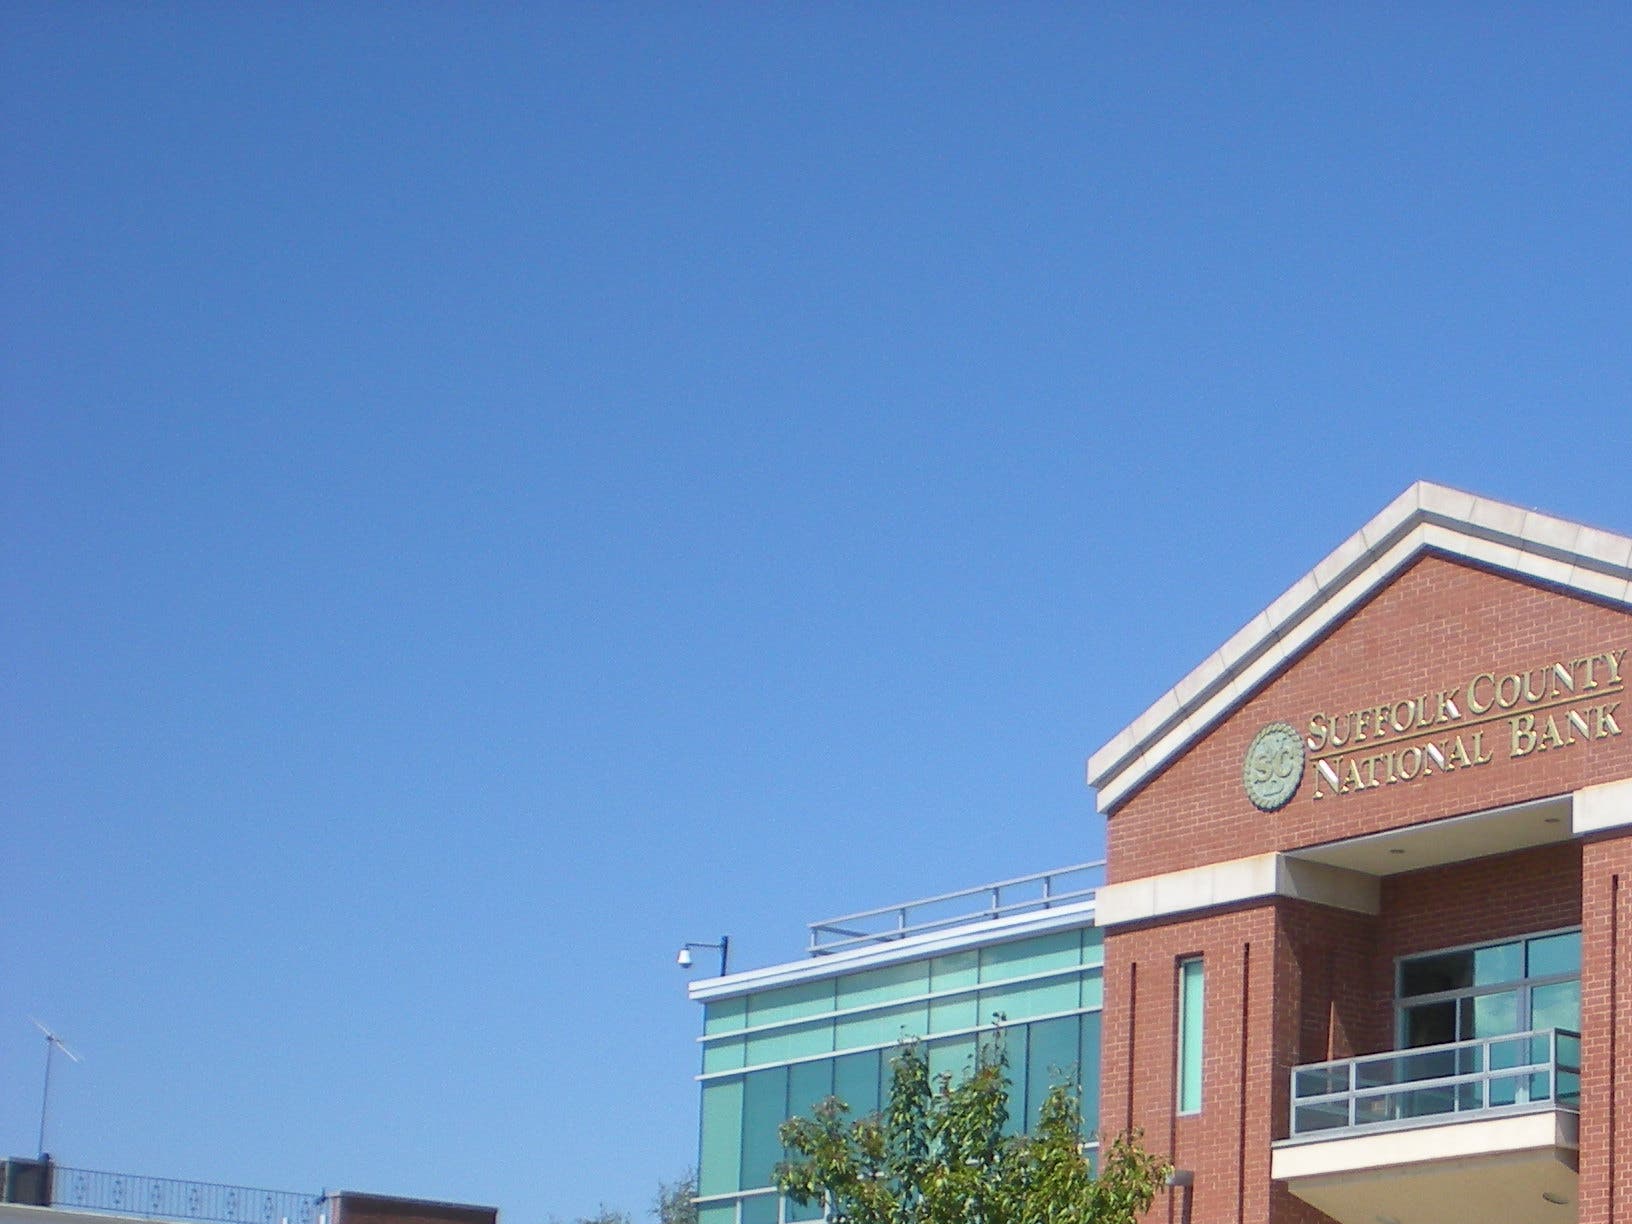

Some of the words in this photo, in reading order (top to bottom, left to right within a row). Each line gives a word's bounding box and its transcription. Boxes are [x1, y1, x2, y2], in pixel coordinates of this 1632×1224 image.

[1307, 686, 1461, 751] SUFFOLK
[1467, 648, 1627, 714] COUNTY
[1313, 730, 1494, 799] NATIONAL
[1509, 701, 1622, 759] BANK
